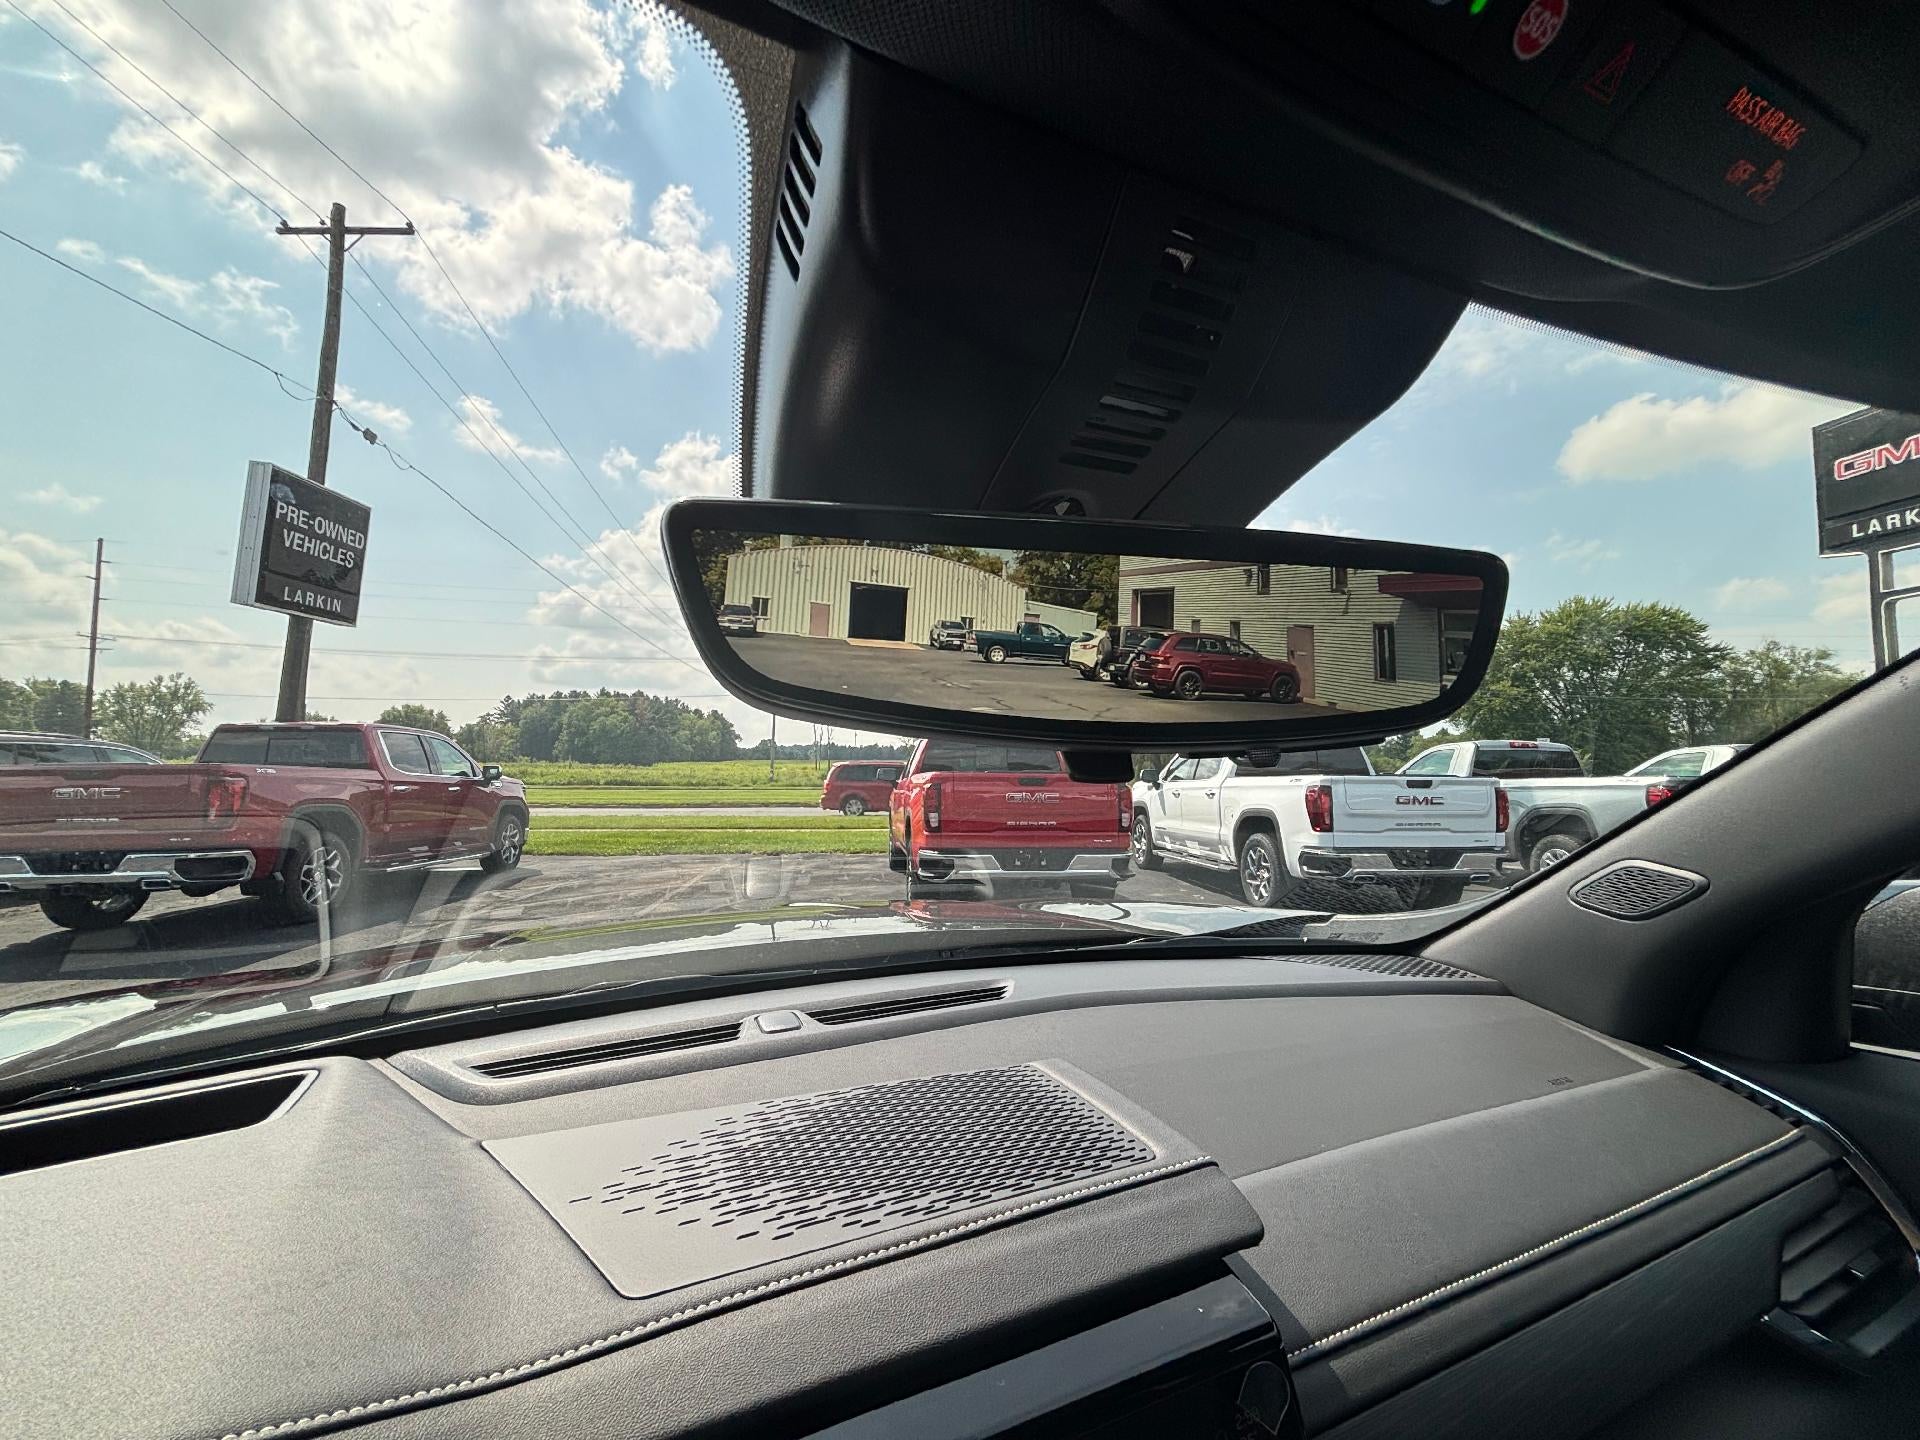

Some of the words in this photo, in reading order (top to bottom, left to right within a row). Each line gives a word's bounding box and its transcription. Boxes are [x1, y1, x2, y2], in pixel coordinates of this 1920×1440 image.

[1518, 5, 1560, 44] SOS
[1725, 85, 1768, 128] PASS
[275, 501, 365, 550] PRE-OWNED
[283, 528, 355, 569] VEHICLES
[283, 586, 342, 613] LARKIN
[52, 787, 121, 800] GMC
[1005, 792, 1060, 804] GMC
[1395, 795, 1445, 806] GMC
